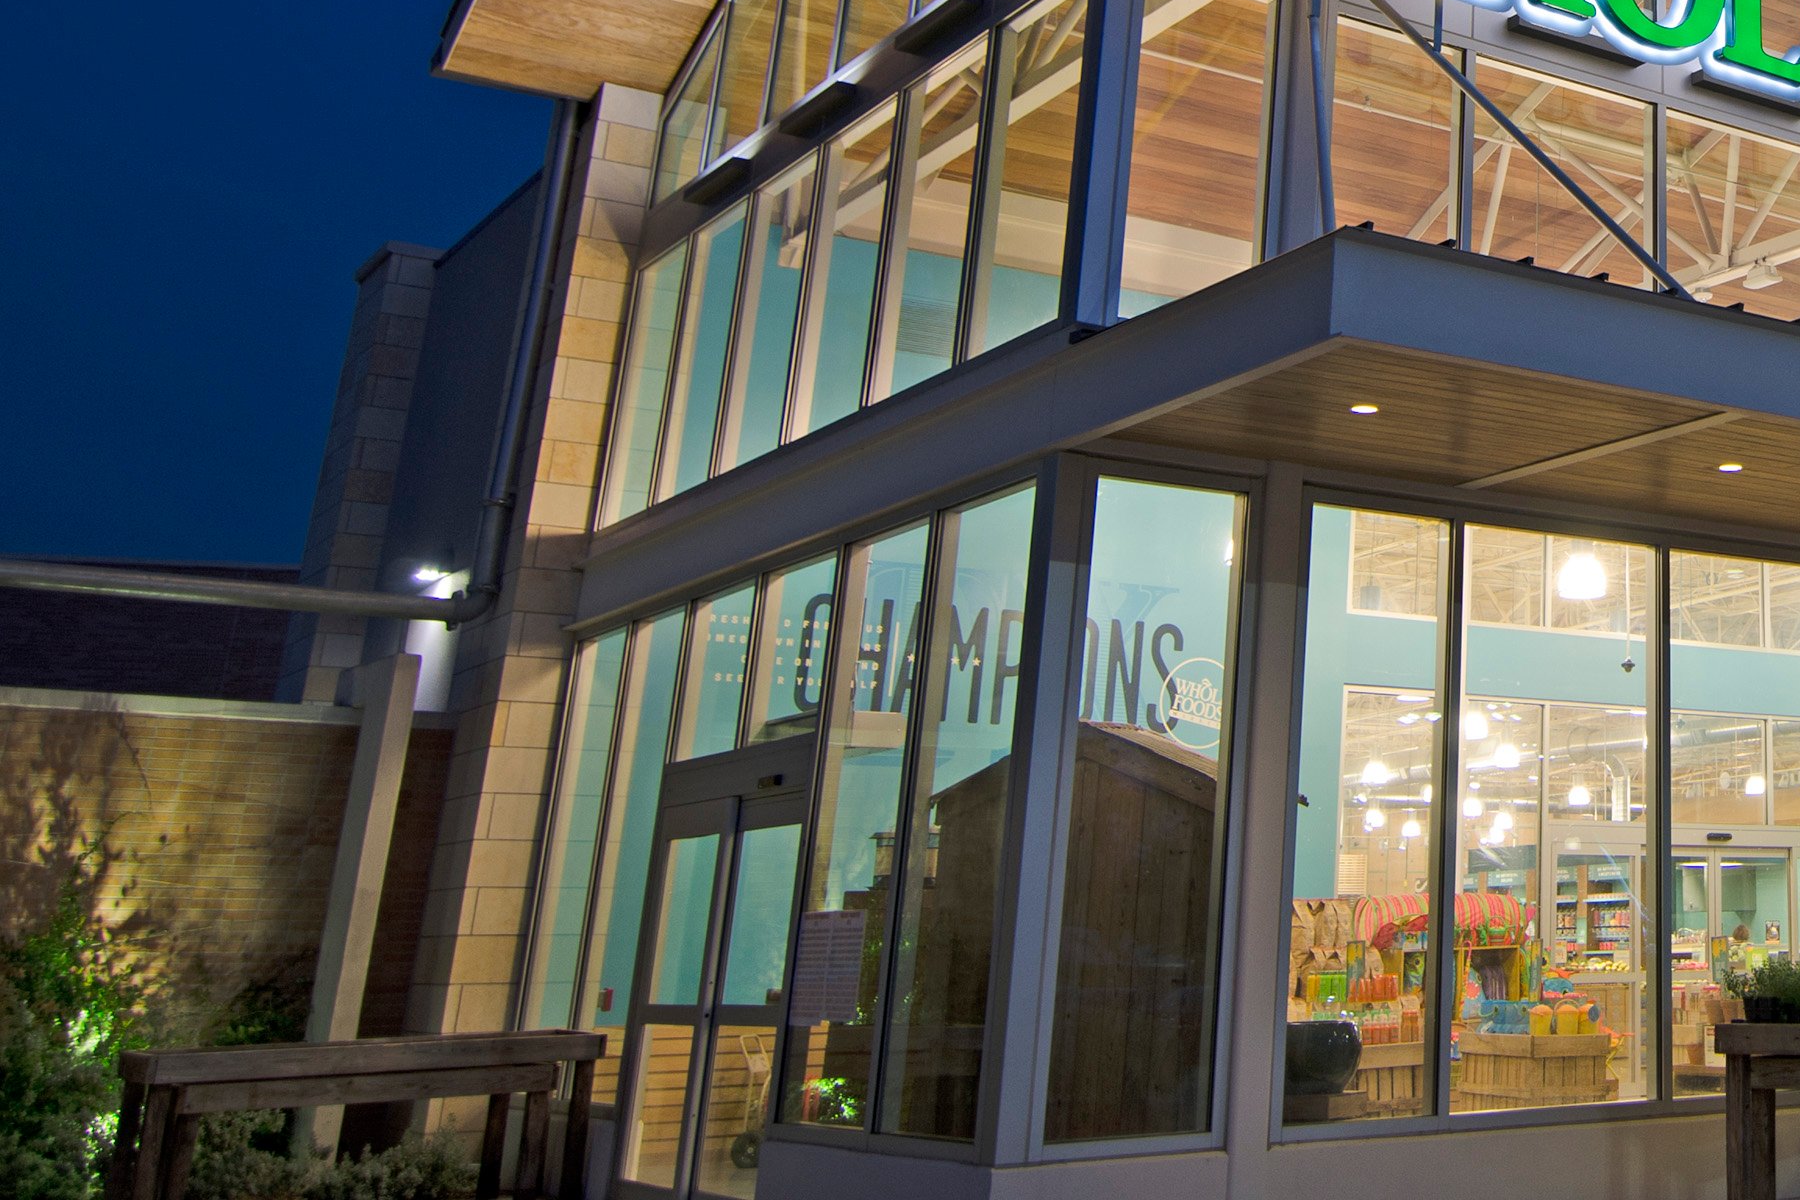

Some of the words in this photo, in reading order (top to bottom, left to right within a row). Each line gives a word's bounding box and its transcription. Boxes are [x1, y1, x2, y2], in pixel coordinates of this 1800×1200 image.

[794, 592, 1184, 734] CHAMPNS
[714, 672, 744, 683] SEE
[1175, 677, 1221, 705] WHOL
